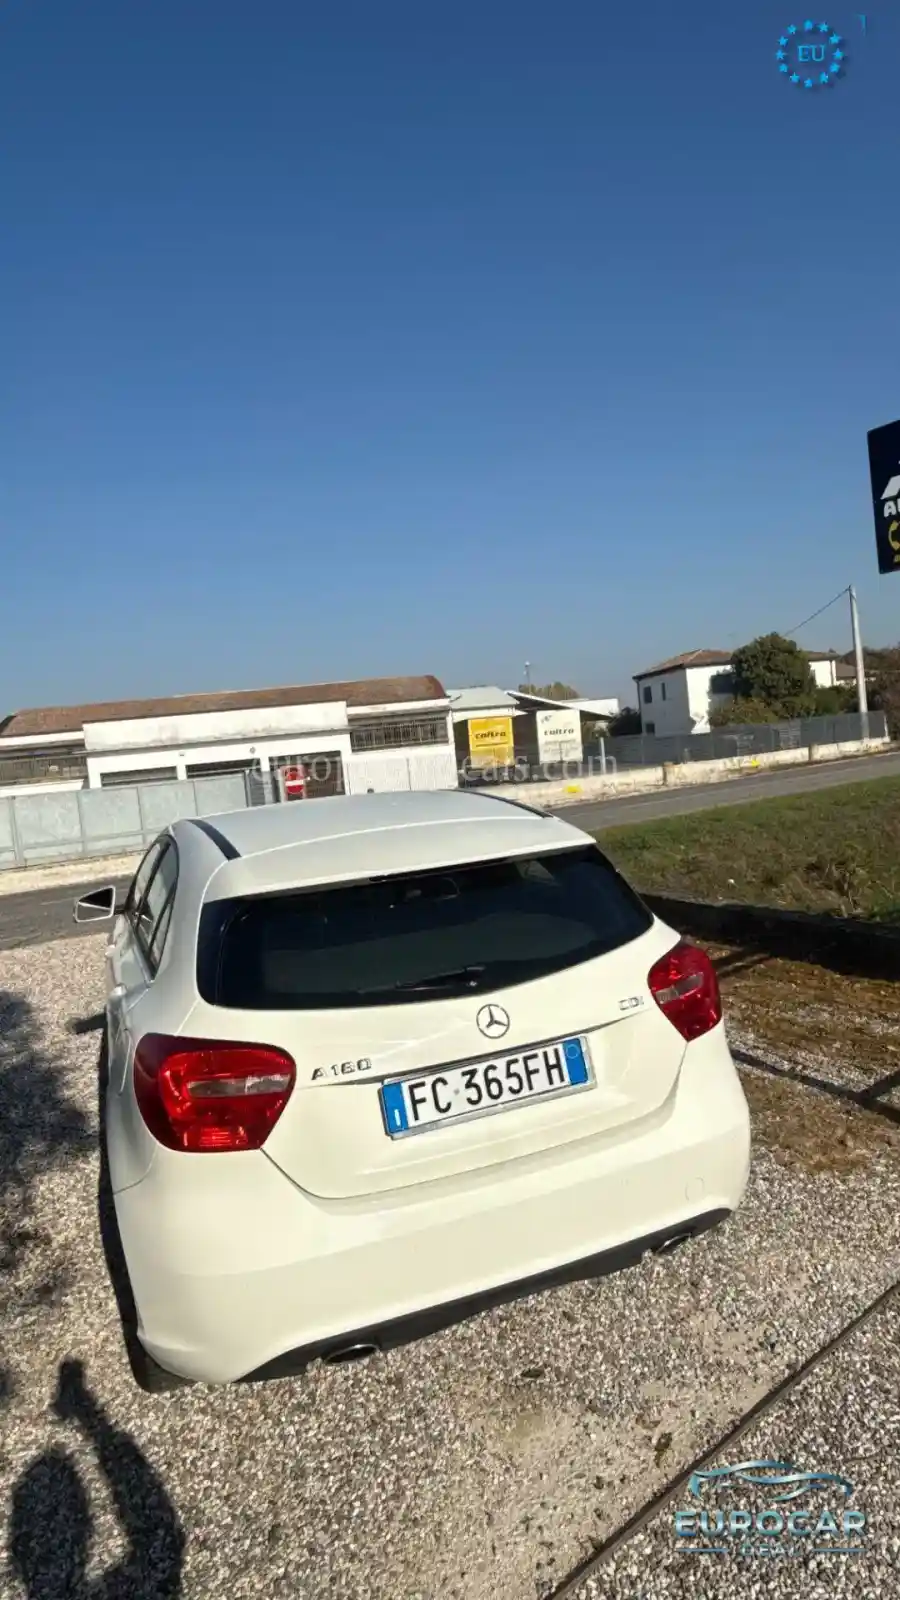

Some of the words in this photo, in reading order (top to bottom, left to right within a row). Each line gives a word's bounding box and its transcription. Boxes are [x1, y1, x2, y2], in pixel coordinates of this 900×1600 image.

[617, 995, 645, 1011] CDI
[408, 1076, 453, 1121] FC
[461, 1047, 567, 1107] 365FH
